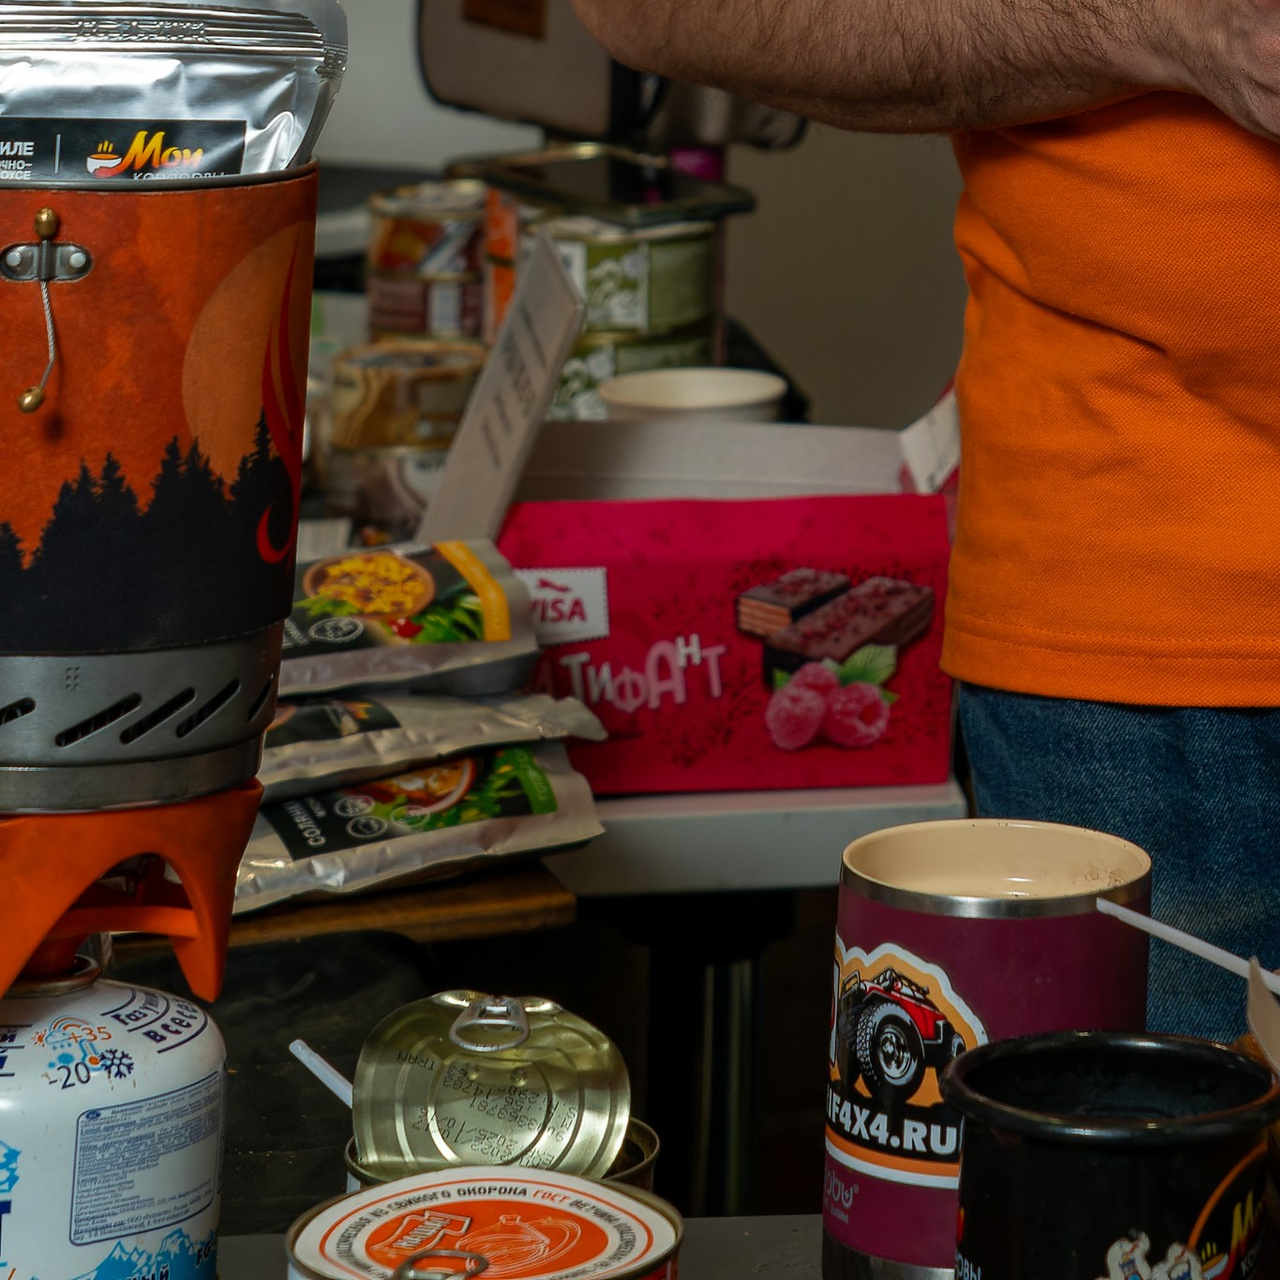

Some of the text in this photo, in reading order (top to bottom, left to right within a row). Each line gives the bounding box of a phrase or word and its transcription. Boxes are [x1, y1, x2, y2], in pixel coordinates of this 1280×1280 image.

[69, 1026, 112, 1043] +35
[49, 1062, 91, 1090] -20
[827, 1085, 957, 1156] IF4X4.RU
